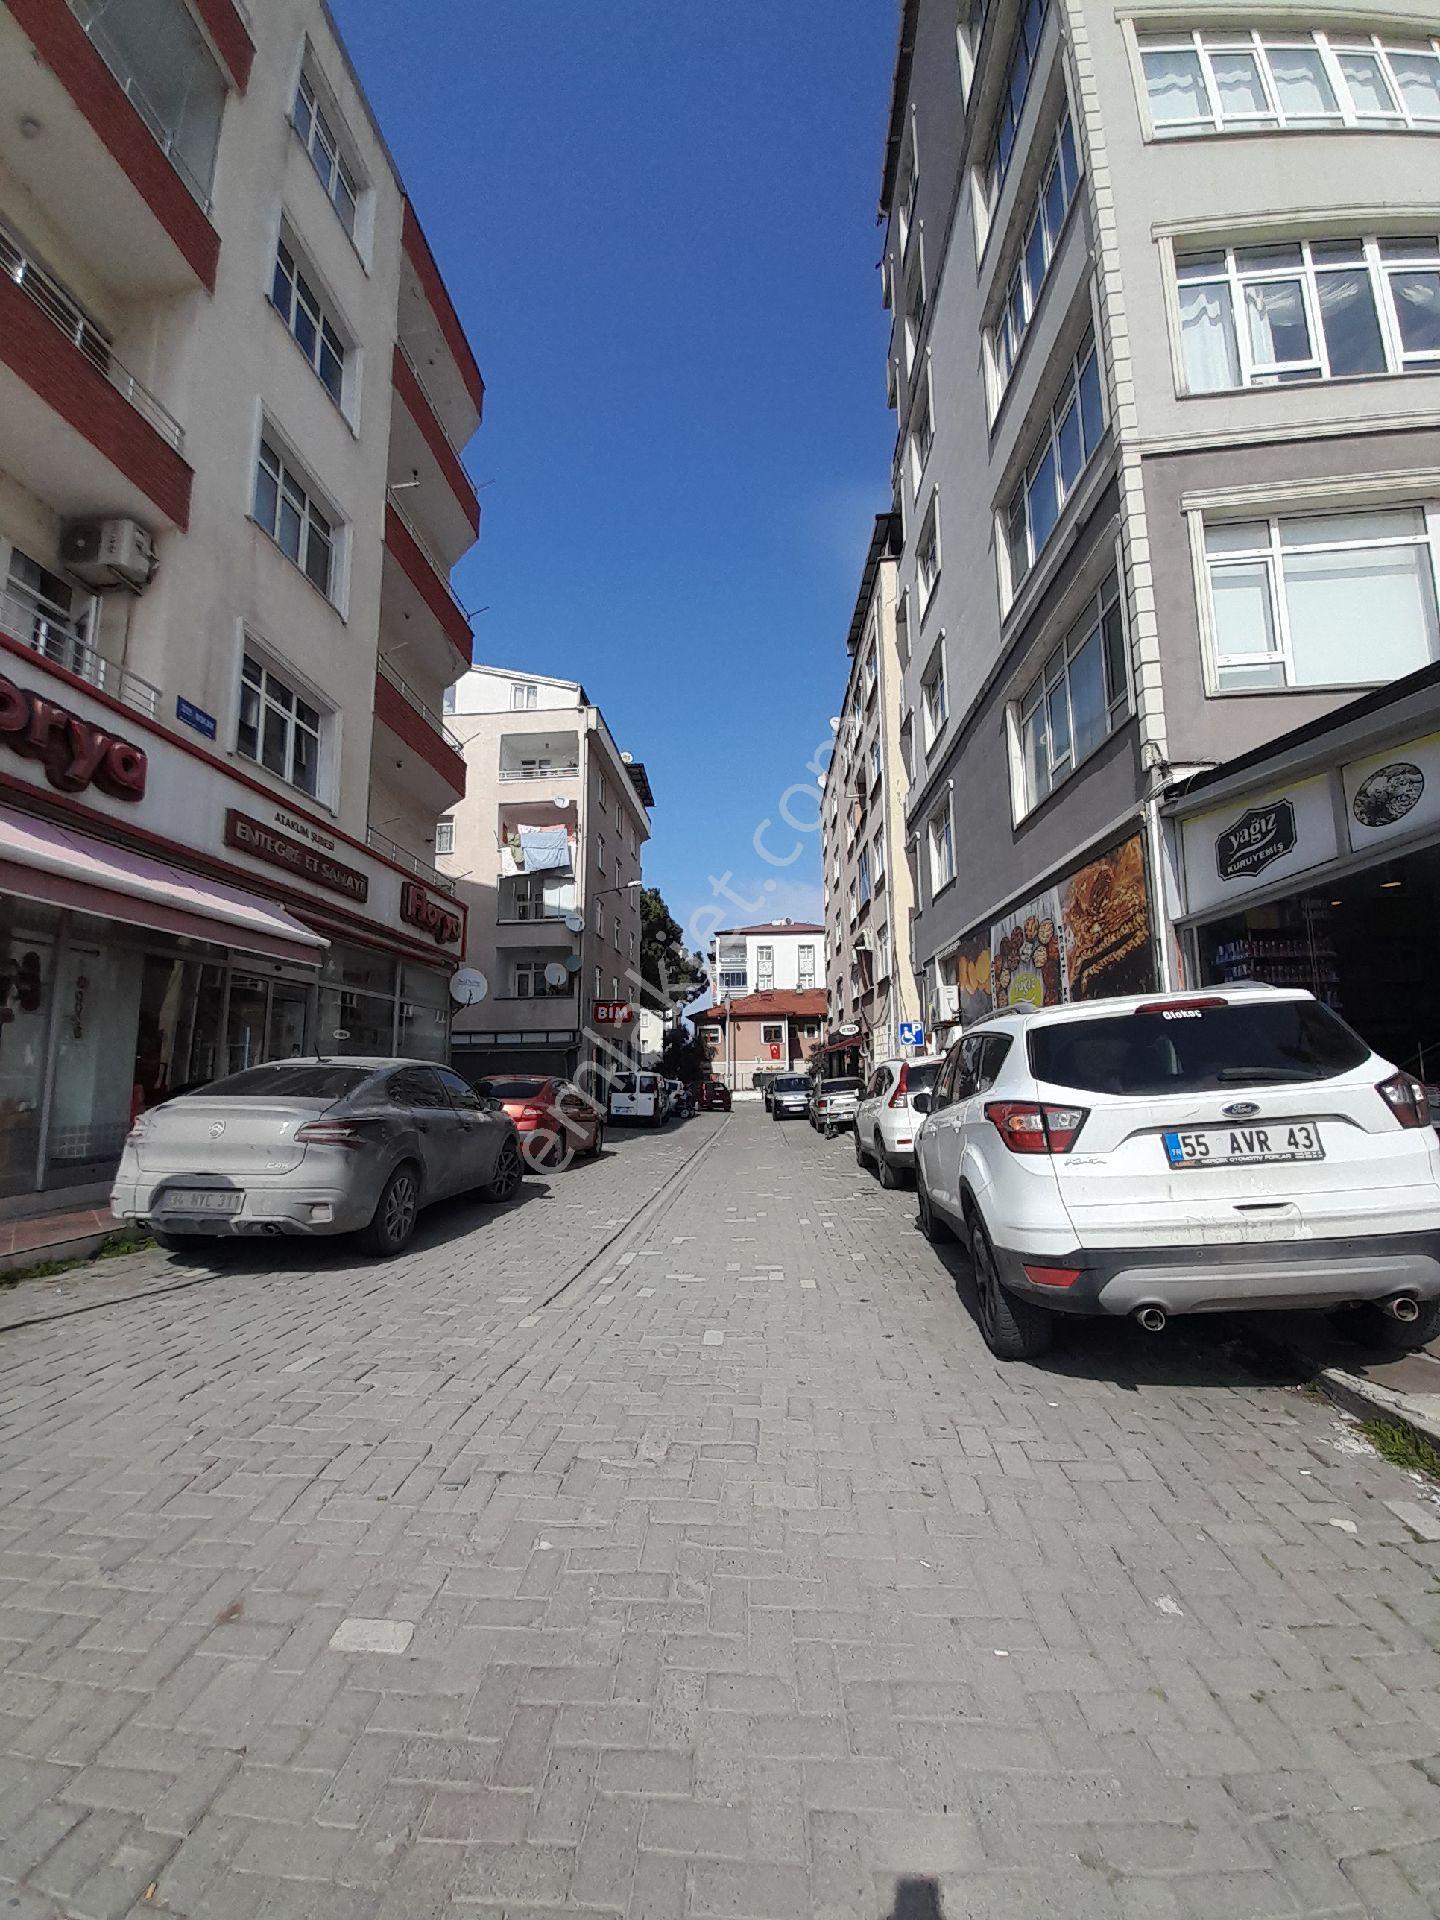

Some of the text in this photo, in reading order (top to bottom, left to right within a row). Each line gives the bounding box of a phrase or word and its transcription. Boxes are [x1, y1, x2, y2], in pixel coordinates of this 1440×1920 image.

[274, 812, 309, 838] ATAKUM
[1228, 813, 1277, 854] yağız
[236, 820, 367, 893] ENTEGRE ET SANAYİ
[1181, 1134, 1210, 1157] 55
[1229, 1130, 1272, 1154] AVR
[1287, 1126, 1314, 1150] 43
